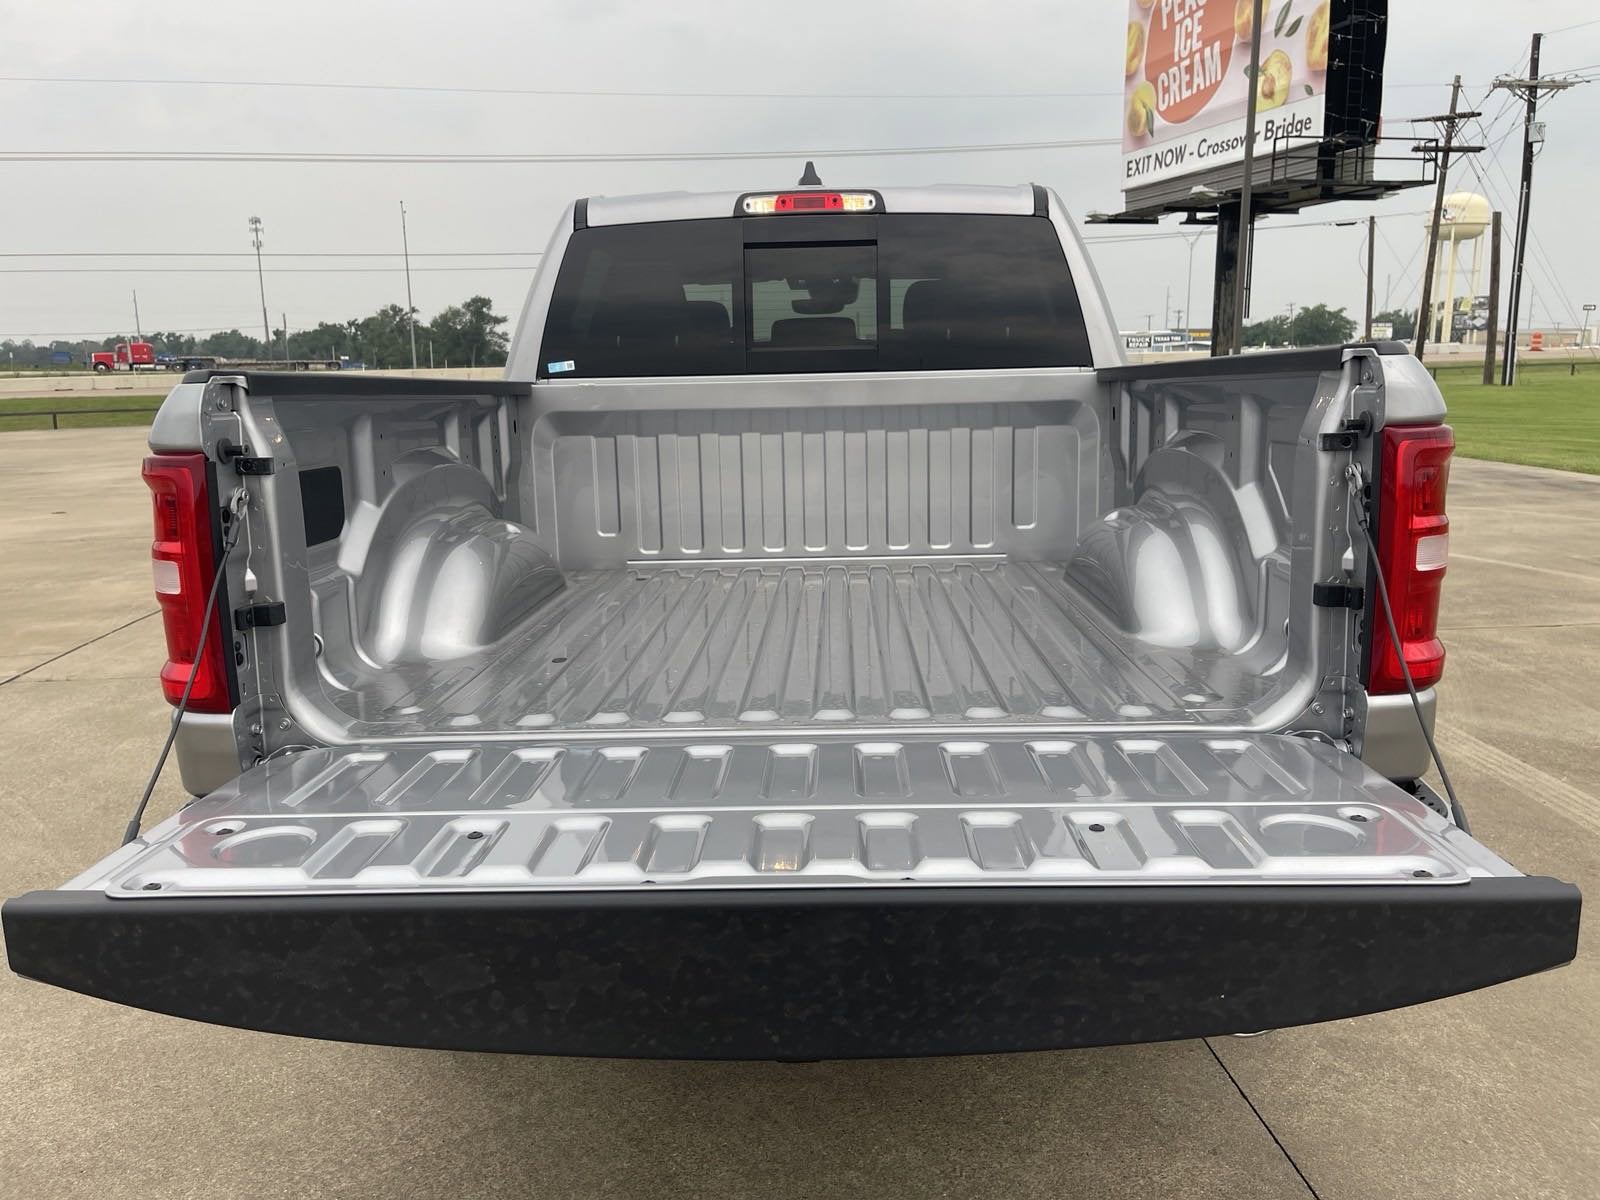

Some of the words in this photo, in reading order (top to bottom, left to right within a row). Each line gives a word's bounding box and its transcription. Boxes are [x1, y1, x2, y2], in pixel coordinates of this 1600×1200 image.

[1173, 9, 1204, 63] ICE
[1157, 40, 1222, 112] CREAM
[1126, 154, 1152, 178] EXIT
[1153, 143, 1187, 171] NOW
[1197, 130, 1261, 158] Crossovr
[1264, 112, 1312, 141] Bridge
